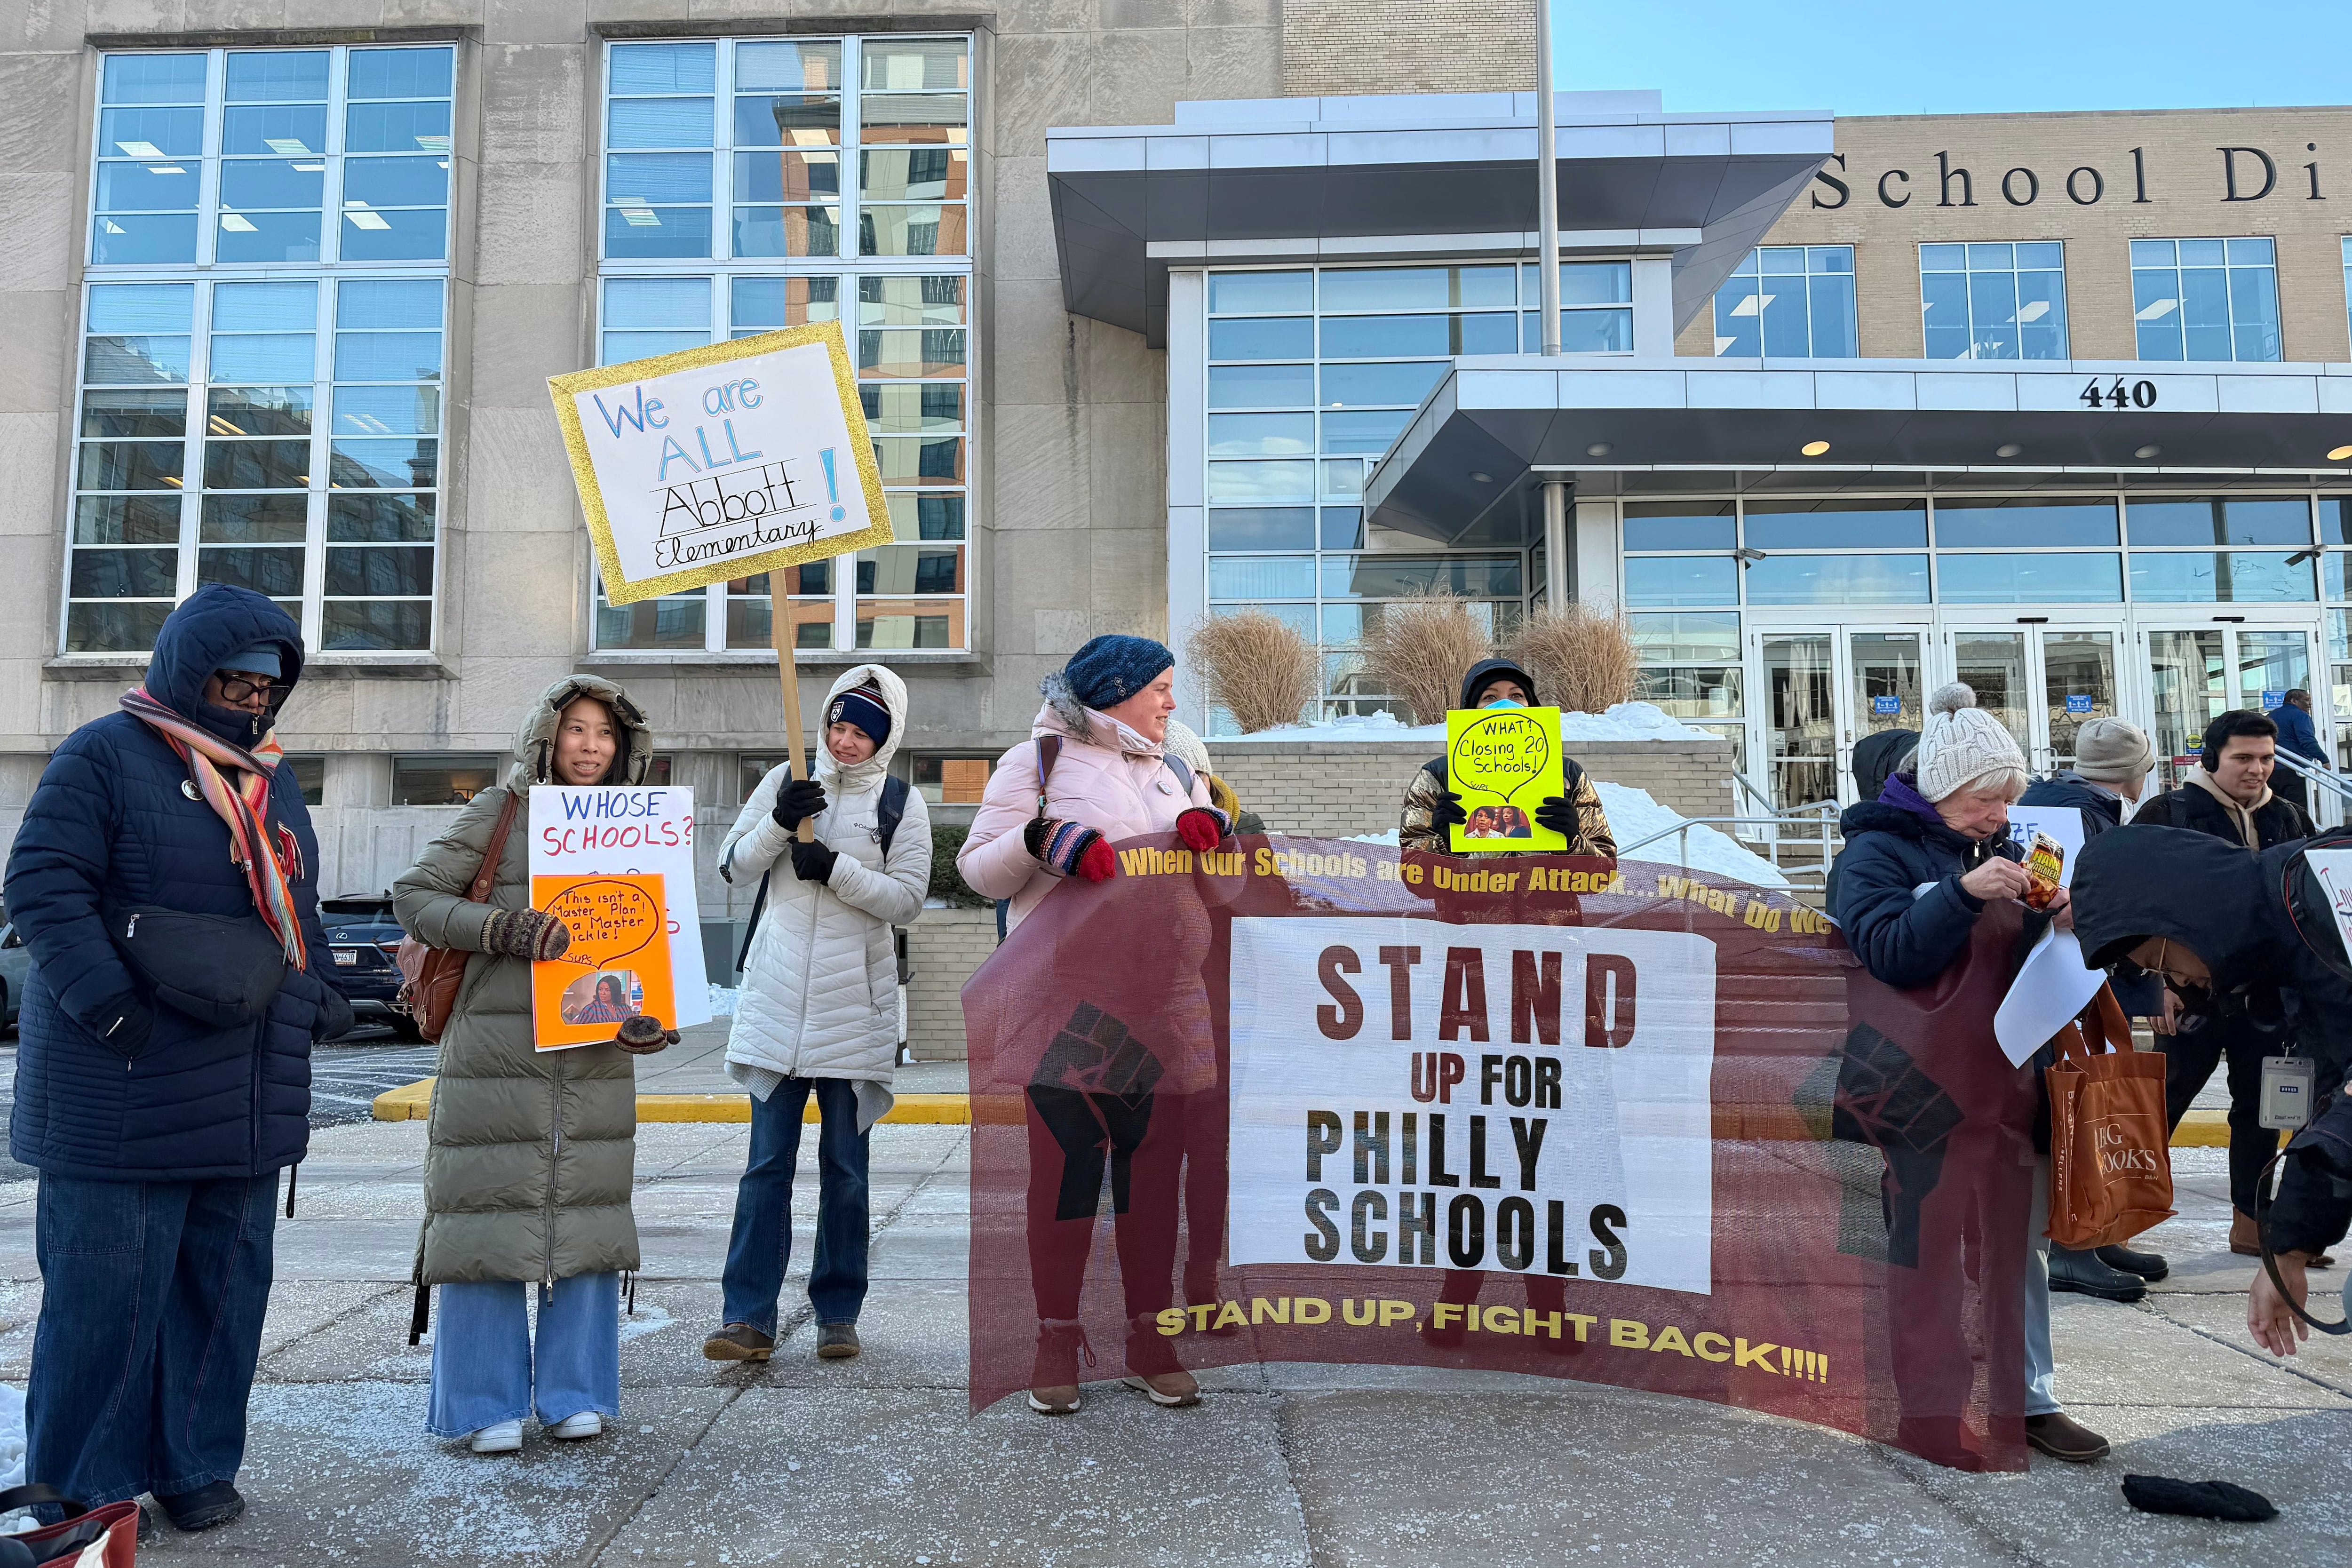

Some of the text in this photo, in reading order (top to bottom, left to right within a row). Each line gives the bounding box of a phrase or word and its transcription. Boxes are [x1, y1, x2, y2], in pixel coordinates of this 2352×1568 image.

[1812, 143, 2326, 209] School Di
[593, 377, 763, 438] We are
[2079, 377, 2157, 408] 440
[659, 419, 763, 481] ALL
[660, 461, 795, 537] Abbott
[655, 517, 819, 568] Elementary
[1460, 736, 1544, 760] Closing 20
[1483, 720, 1532, 735] WHAT?
[1474, 755, 1536, 774] Schools!
[562, 791, 667, 820] WHOSE
[543, 815, 693, 856] SCHOOLS?
[553, 905, 595, 917] Master
[564, 890, 590, 904] This
[632, 893, 640, 902] a
[1118, 846, 1192, 876] When
[1200, 850, 1246, 876] Our
[1255, 847, 1367, 879] Schools
[1376, 859, 1424, 883] are
[1433, 866, 1520, 893] Under
[1744, 899, 1781, 933] Do
[1790, 905, 1832, 935] We
[591, 916, 644, 929] Master
[1316, 945, 1637, 1049] STAND
[1411, 1052, 1562, 1109] UP FOR
[1306, 1110, 1549, 1191] PHILLY
[1303, 1188, 1628, 1281] SCHOOLS
[1156, 1297, 1828, 1384] STAND UP, FIGHT BACK!!!!
